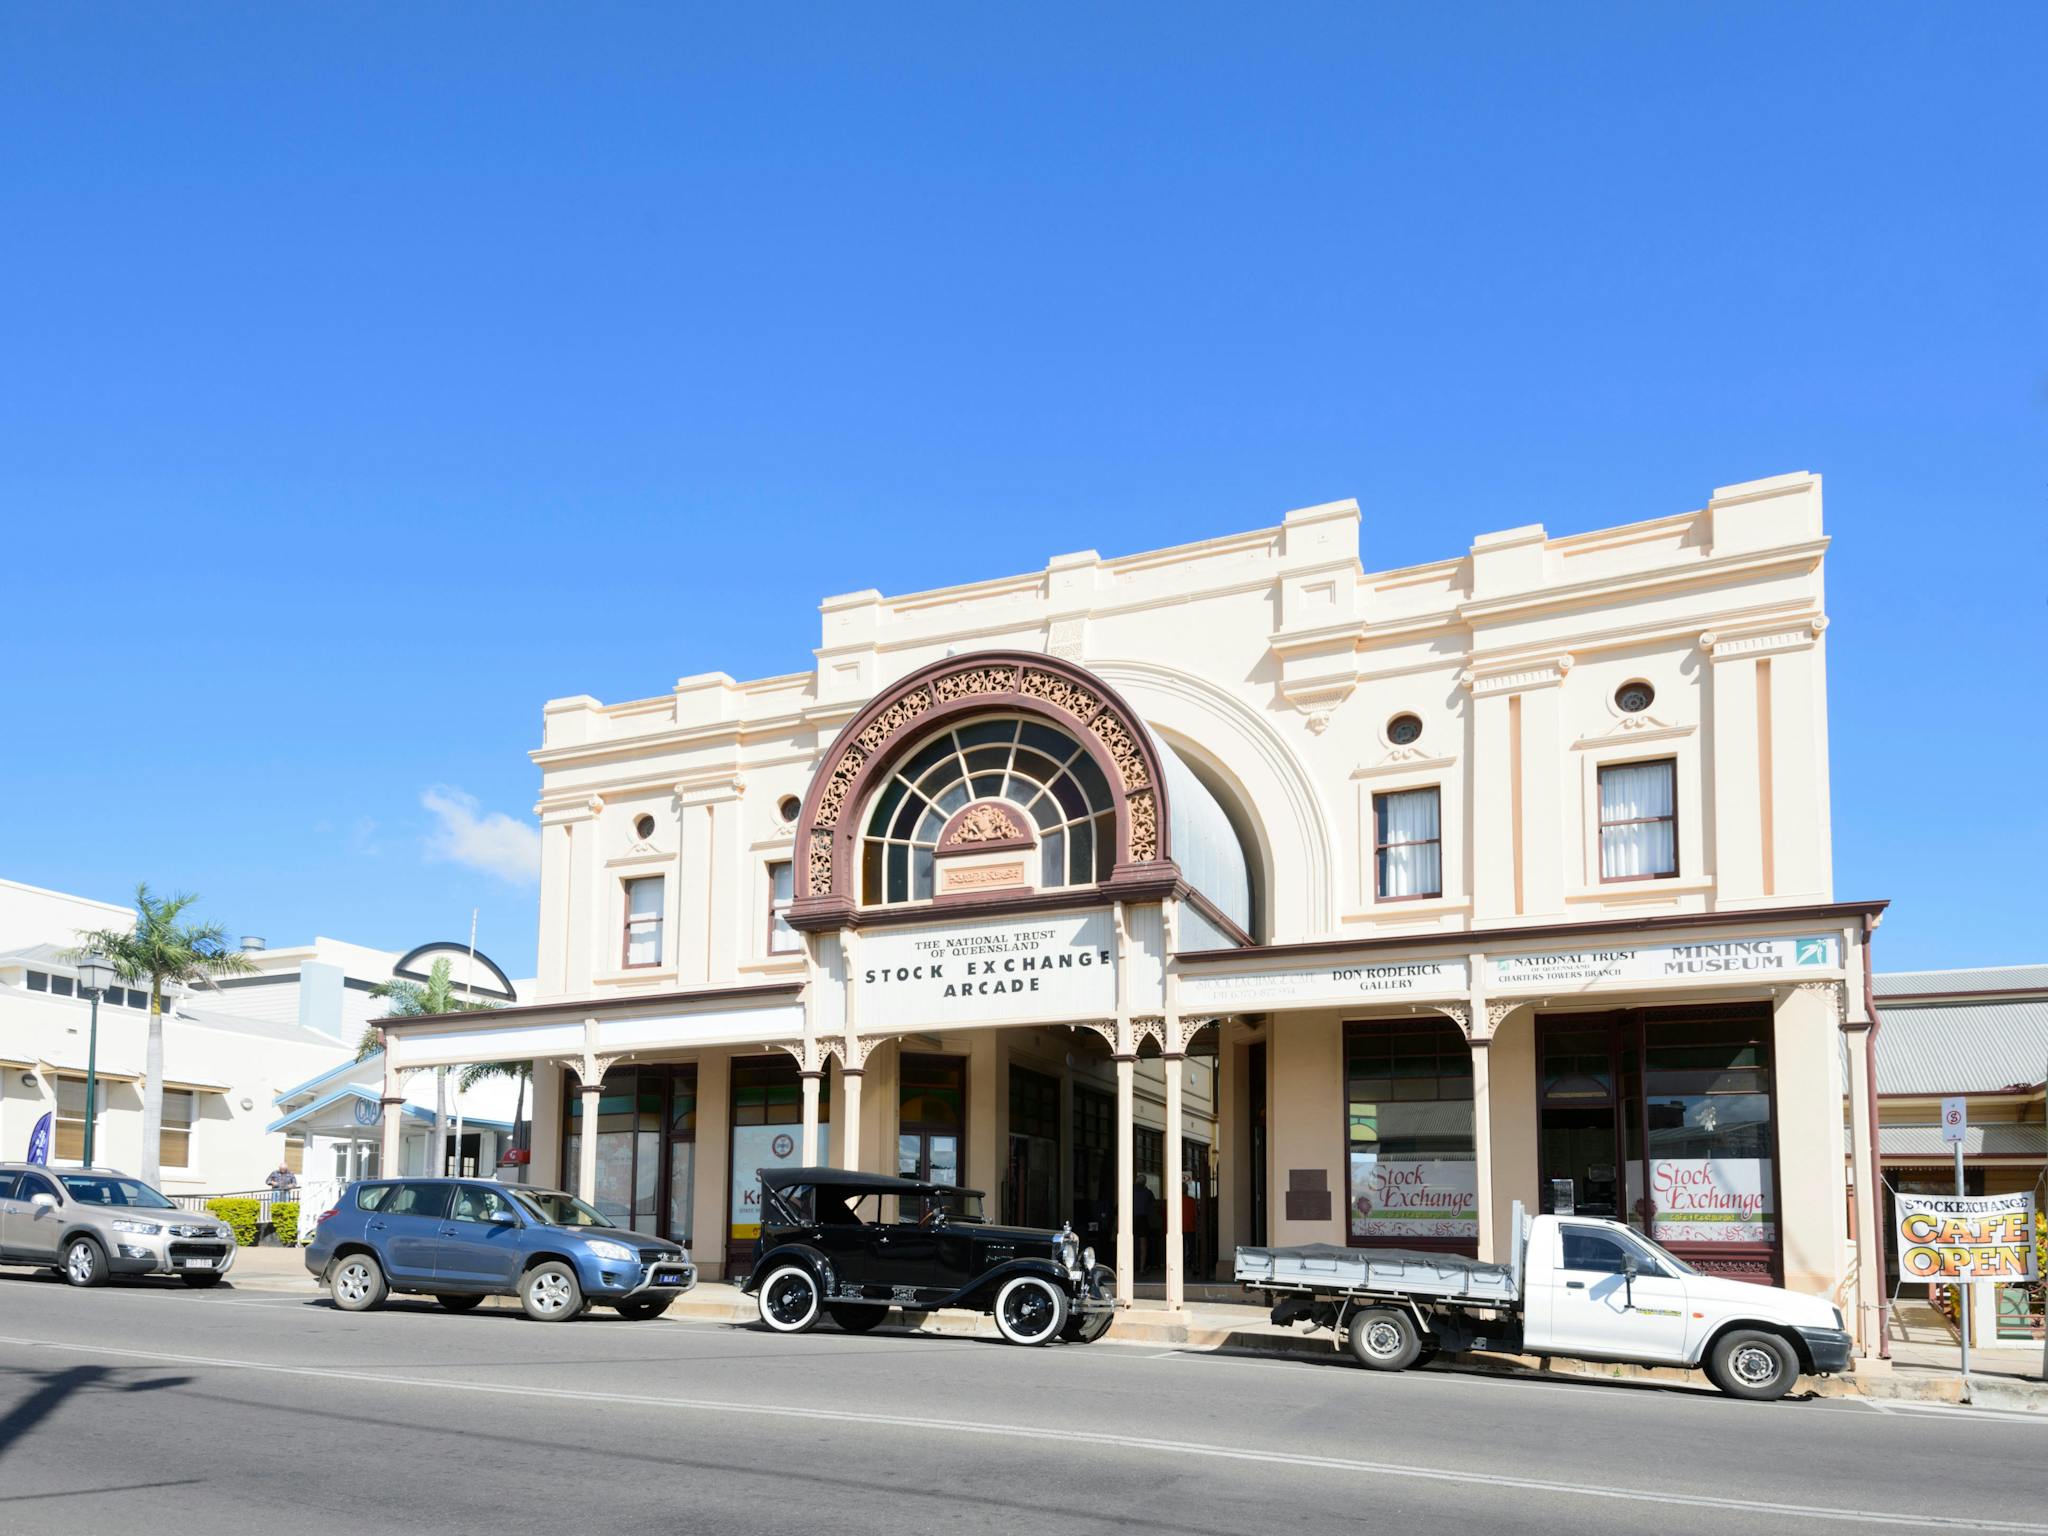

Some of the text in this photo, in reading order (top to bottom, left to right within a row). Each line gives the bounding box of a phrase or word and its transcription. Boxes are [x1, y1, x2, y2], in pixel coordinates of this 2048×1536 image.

[915, 930, 1056, 951] THE NATIONAL TRUST
[930, 941, 1039, 958] OF QUEENSLAND
[1672, 941, 1775, 960] MINING
[865, 950, 1110, 984] STOCK EXCHANGE
[1515, 950, 1637, 968] NATIONAL TRUST
[1542, 964, 1590, 972] QUEENSLAND
[1664, 955, 1784, 975] MUSEUM
[1332, 963, 1442, 982] DON RODERICK
[1498, 968, 1621, 983] CHARTERS TOWERS BRANCH
[943, 977, 1039, 998] ARCADE
[1360, 979, 1415, 991] GALLERY
[1368, 1164, 1425, 1191] Stock
[1653, 1162, 1713, 1192] Stock
[1379, 1185, 1473, 1216] Exchange
[1665, 1185, 1765, 1219] Exchange
[1901, 1212, 2029, 1244] CAFE
[1903, 1245, 2031, 1277] OPEN
